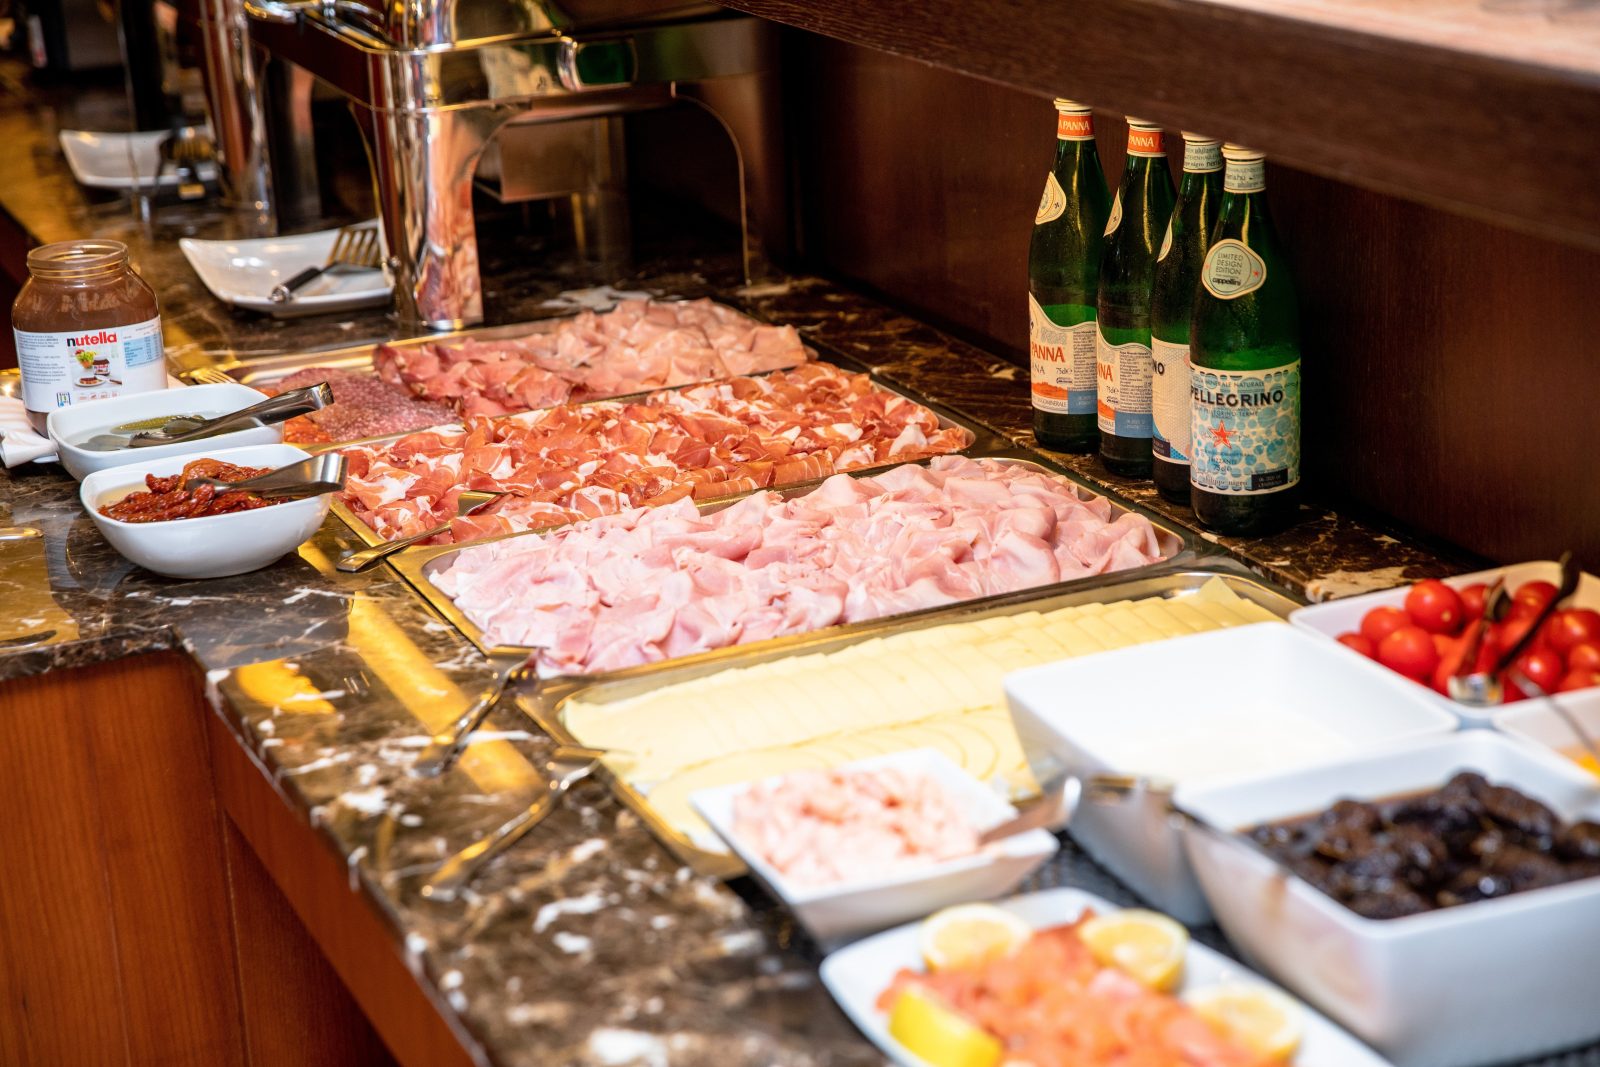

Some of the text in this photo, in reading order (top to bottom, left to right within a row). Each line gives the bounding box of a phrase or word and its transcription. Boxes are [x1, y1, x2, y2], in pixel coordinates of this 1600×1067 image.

[1063, 120, 1090, 131] PANNA
[1217, 253, 1244, 261] LIMITED
[1217, 259, 1243, 268] DESIGN
[1215, 265, 1241, 275] EDITION
[66, 331, 118, 348] nutella
[1191, 384, 1284, 408] PELLEGRINO
